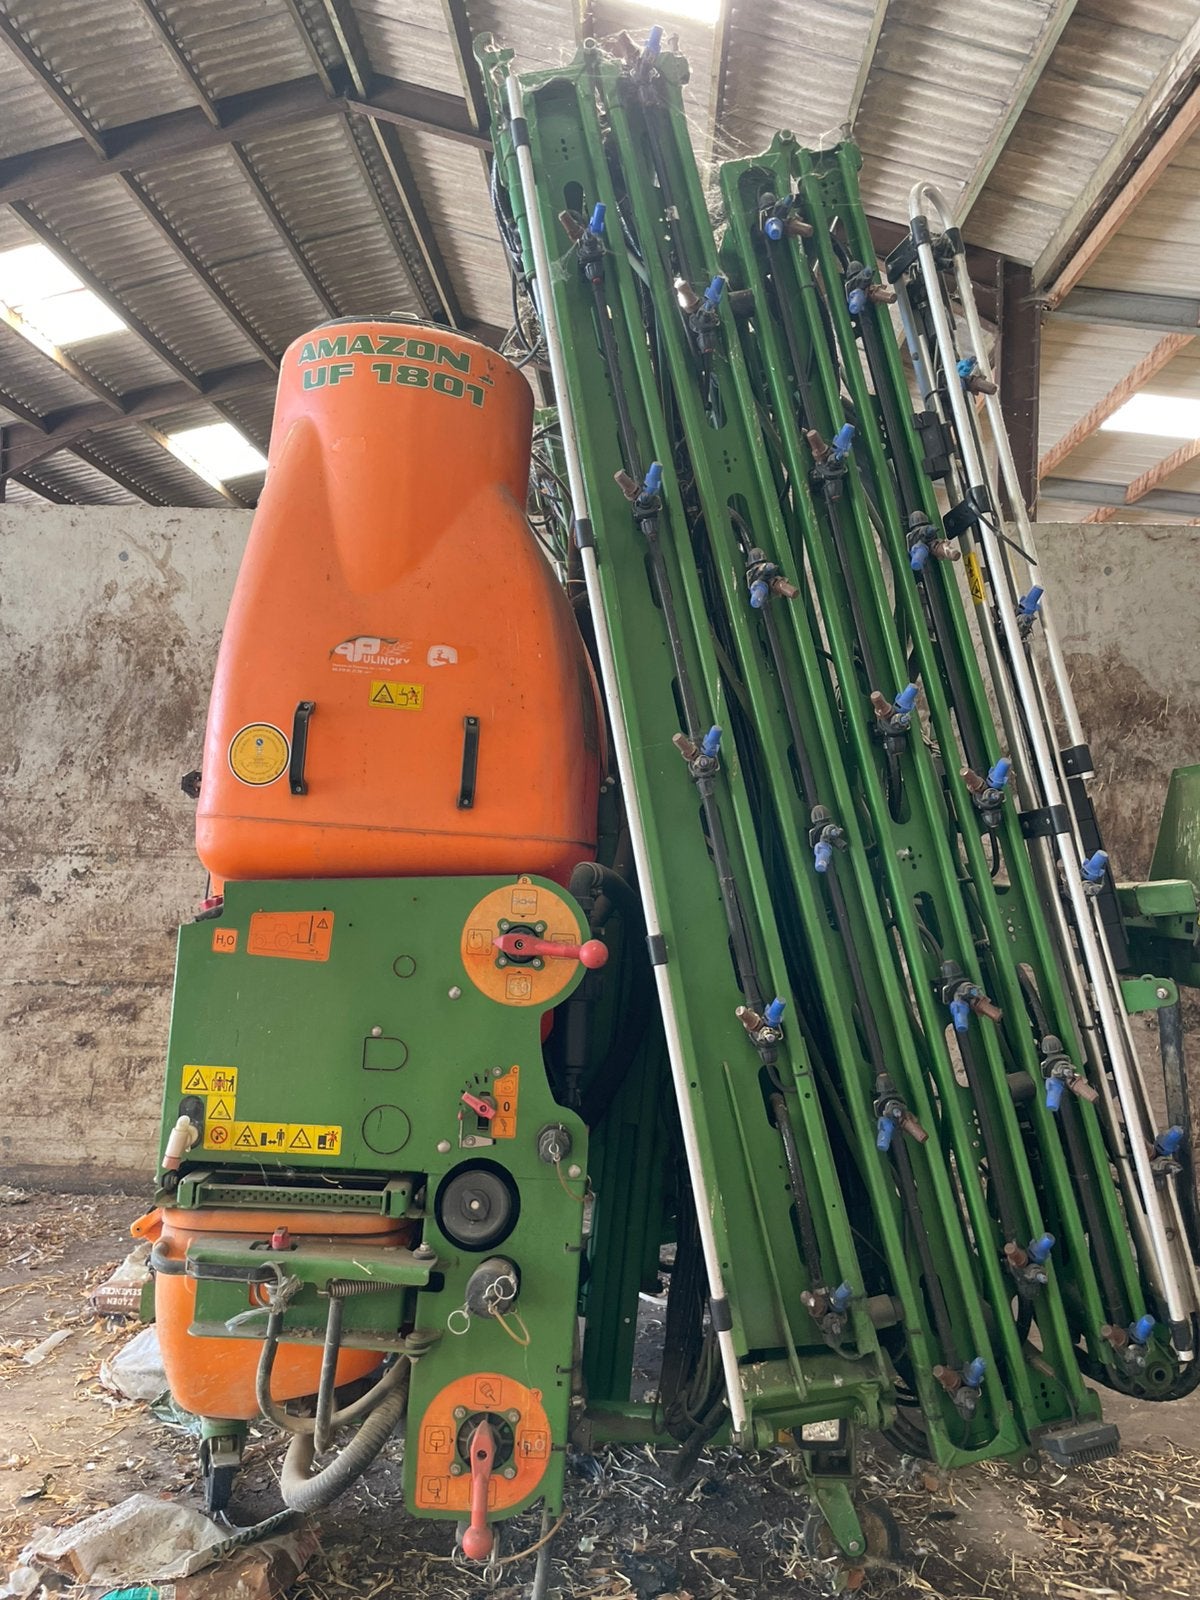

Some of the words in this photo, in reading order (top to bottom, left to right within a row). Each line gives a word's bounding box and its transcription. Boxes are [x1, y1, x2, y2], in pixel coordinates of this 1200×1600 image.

[303, 363, 354, 390] UF
[371, 363, 484, 407] 1801
[504, 1101, 511, 1111] 0
[107, 1297, 134, 1305] ZADEN
